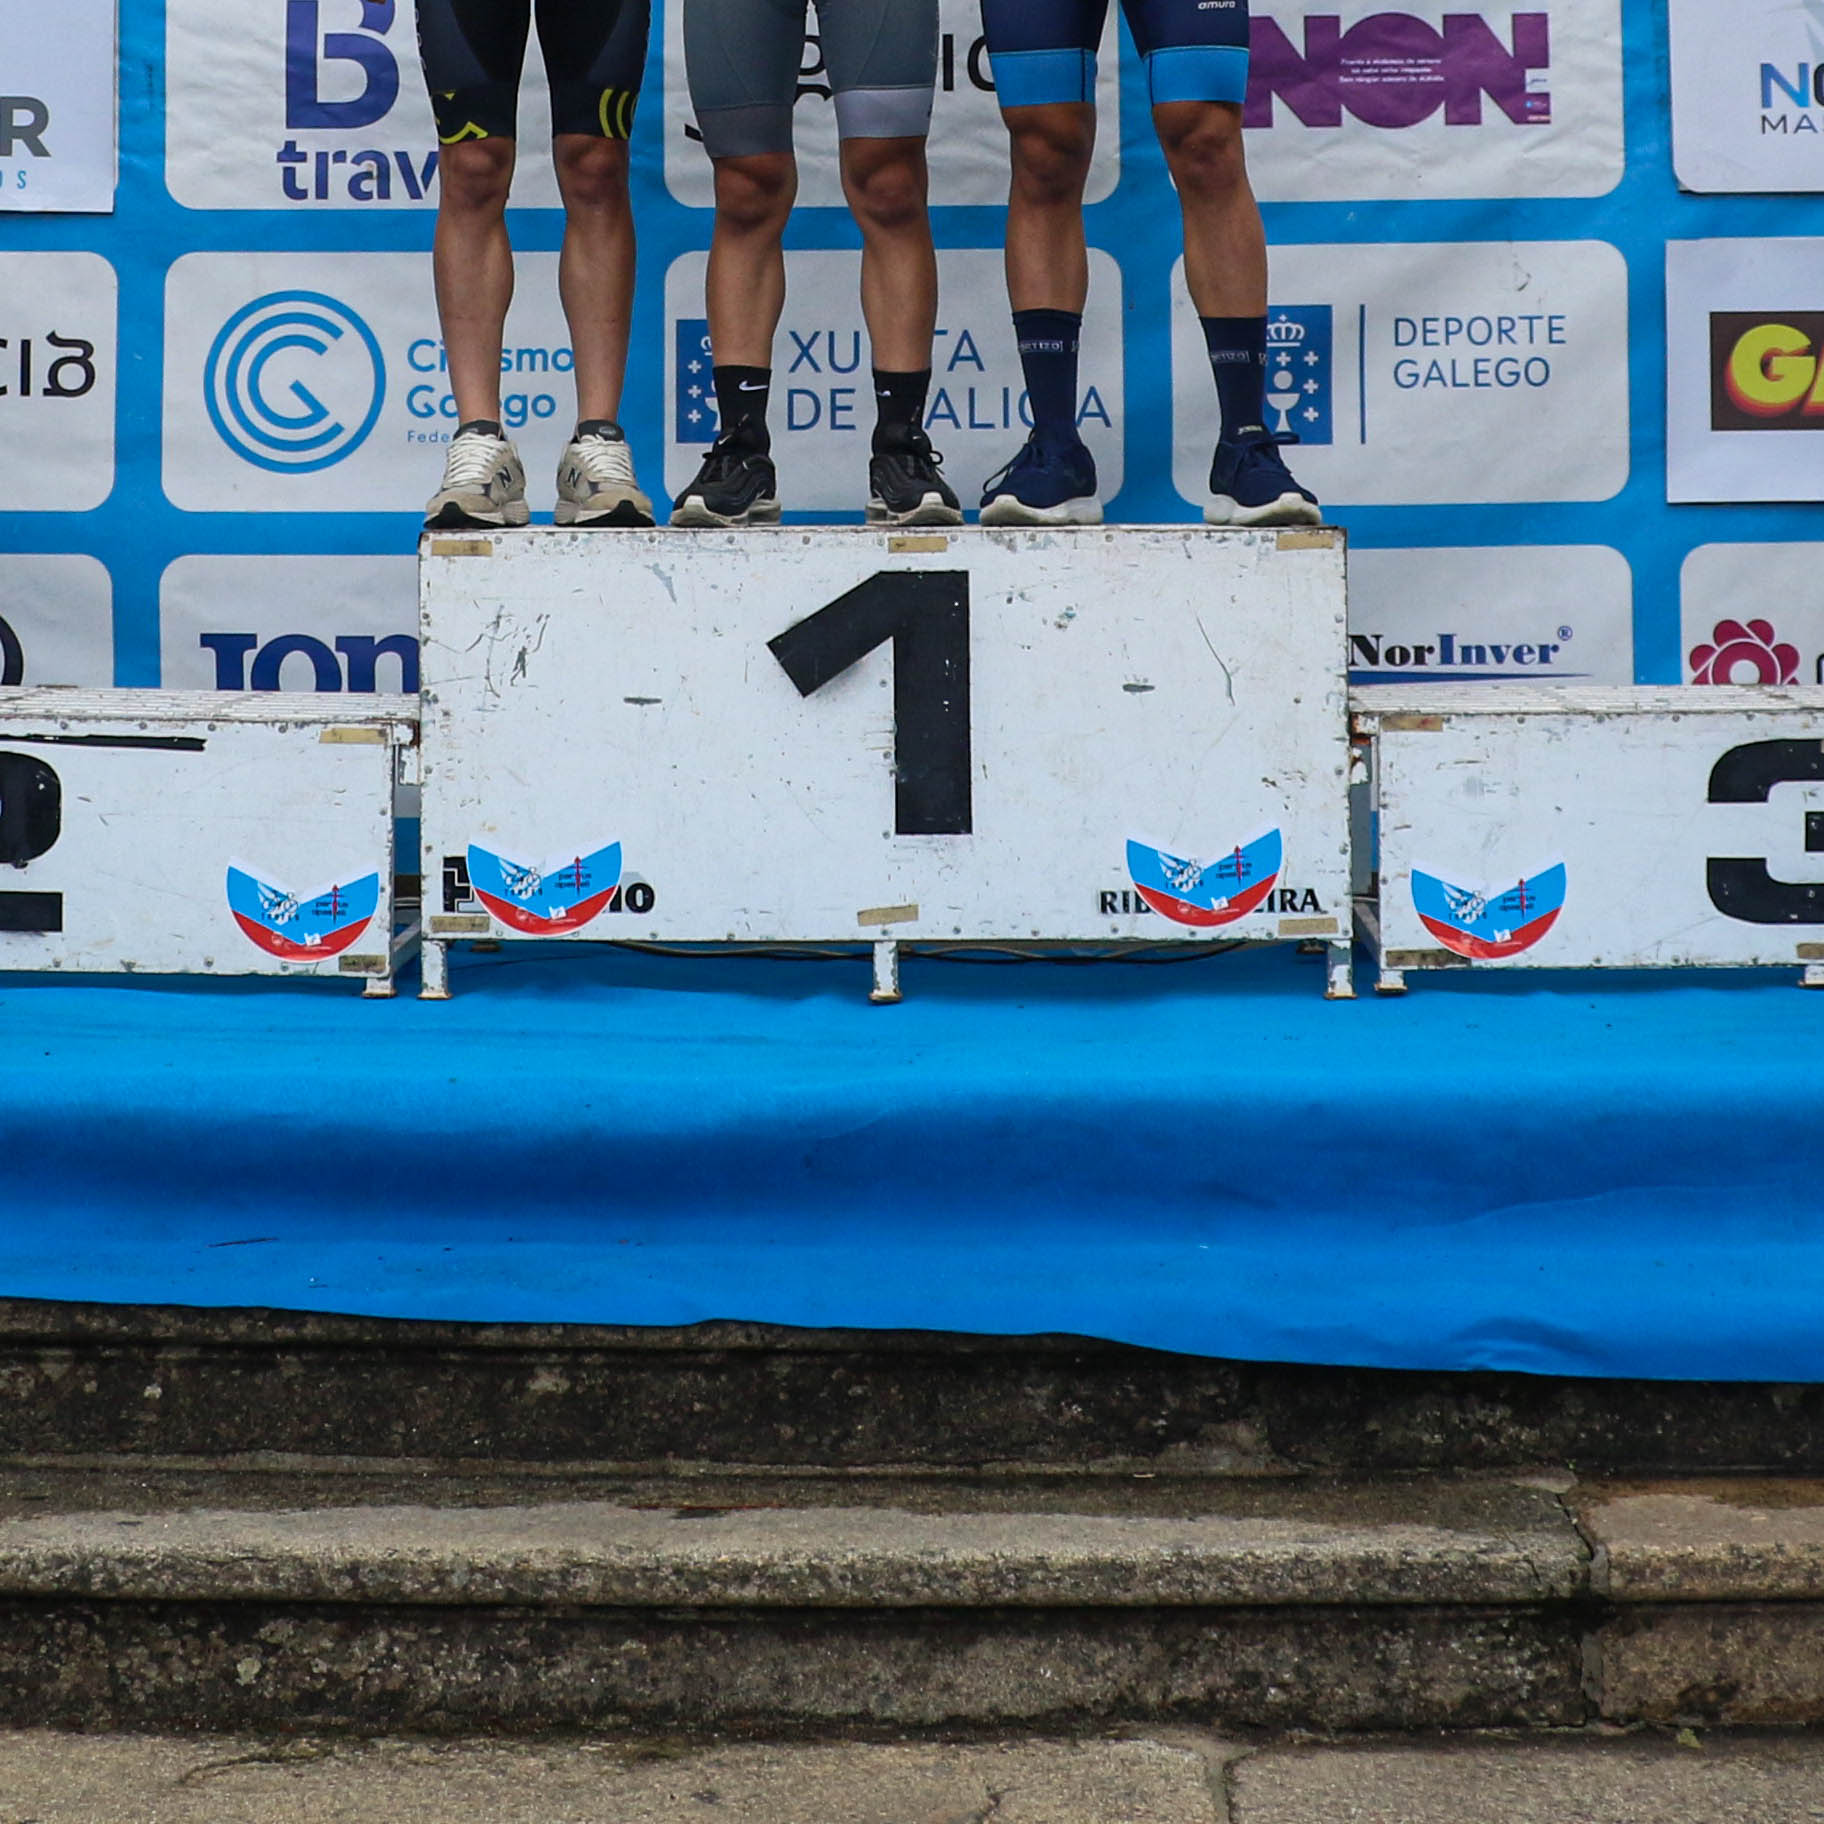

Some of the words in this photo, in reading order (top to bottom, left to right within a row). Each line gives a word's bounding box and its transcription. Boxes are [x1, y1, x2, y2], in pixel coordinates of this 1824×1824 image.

[1393, 315, 1567, 347] DEPORTE
[1393, 356, 1551, 389] GALEGO
[787, 388, 856, 431] DE
[767, 570, 972, 836] 1
